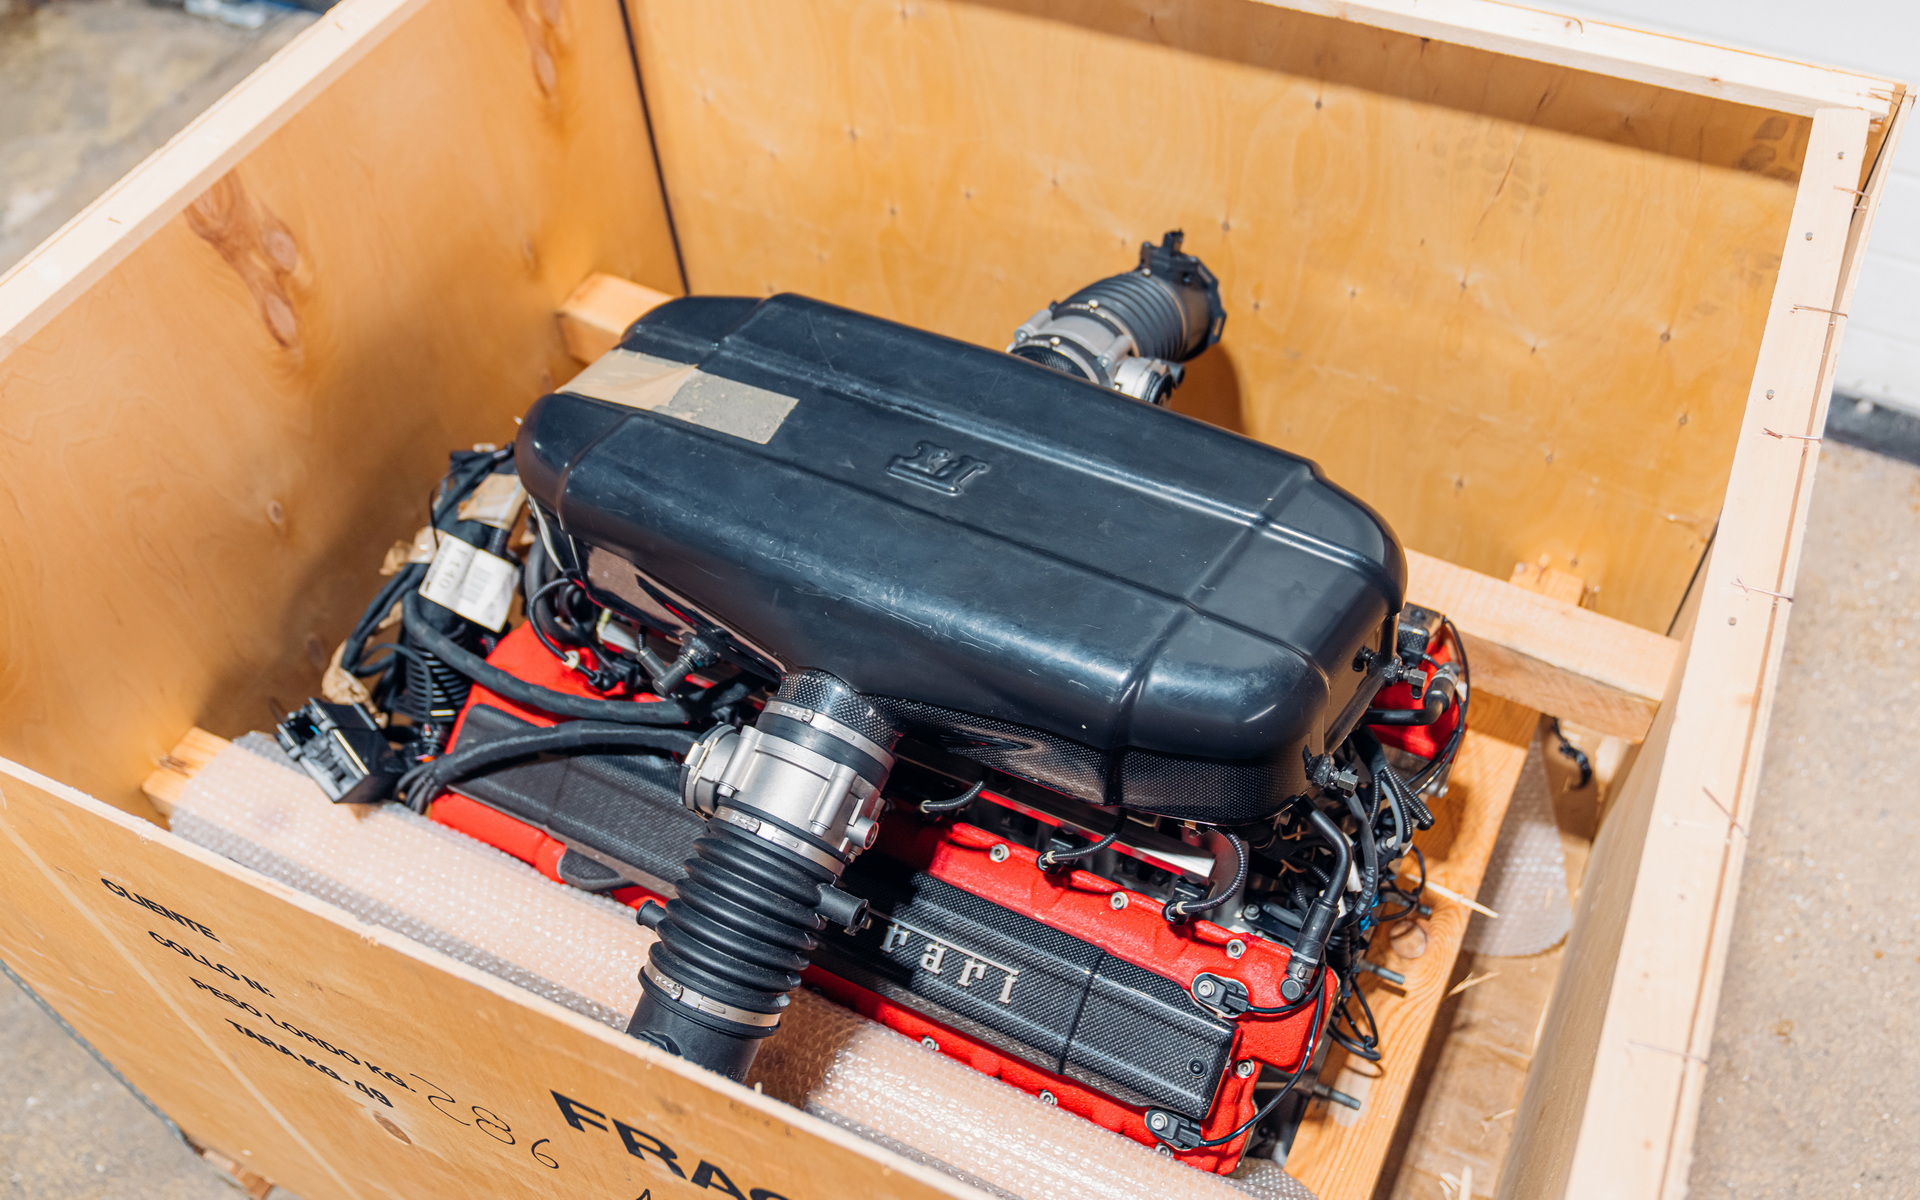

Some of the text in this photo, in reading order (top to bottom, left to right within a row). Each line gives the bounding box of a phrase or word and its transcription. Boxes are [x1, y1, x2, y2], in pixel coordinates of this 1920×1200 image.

[100, 877, 221, 943] CLIENTE
[147, 930, 240, 981] COLLO
[844, 908, 1020, 1004] rari
[188, 976, 417, 1093] PESO LORDO KG.
[225, 1017, 300, 1061] TARA
[299, 1054, 350, 1085] KG.
[409, 1072, 559, 1170] 286
[549, 1088, 792, 1200] FRA
